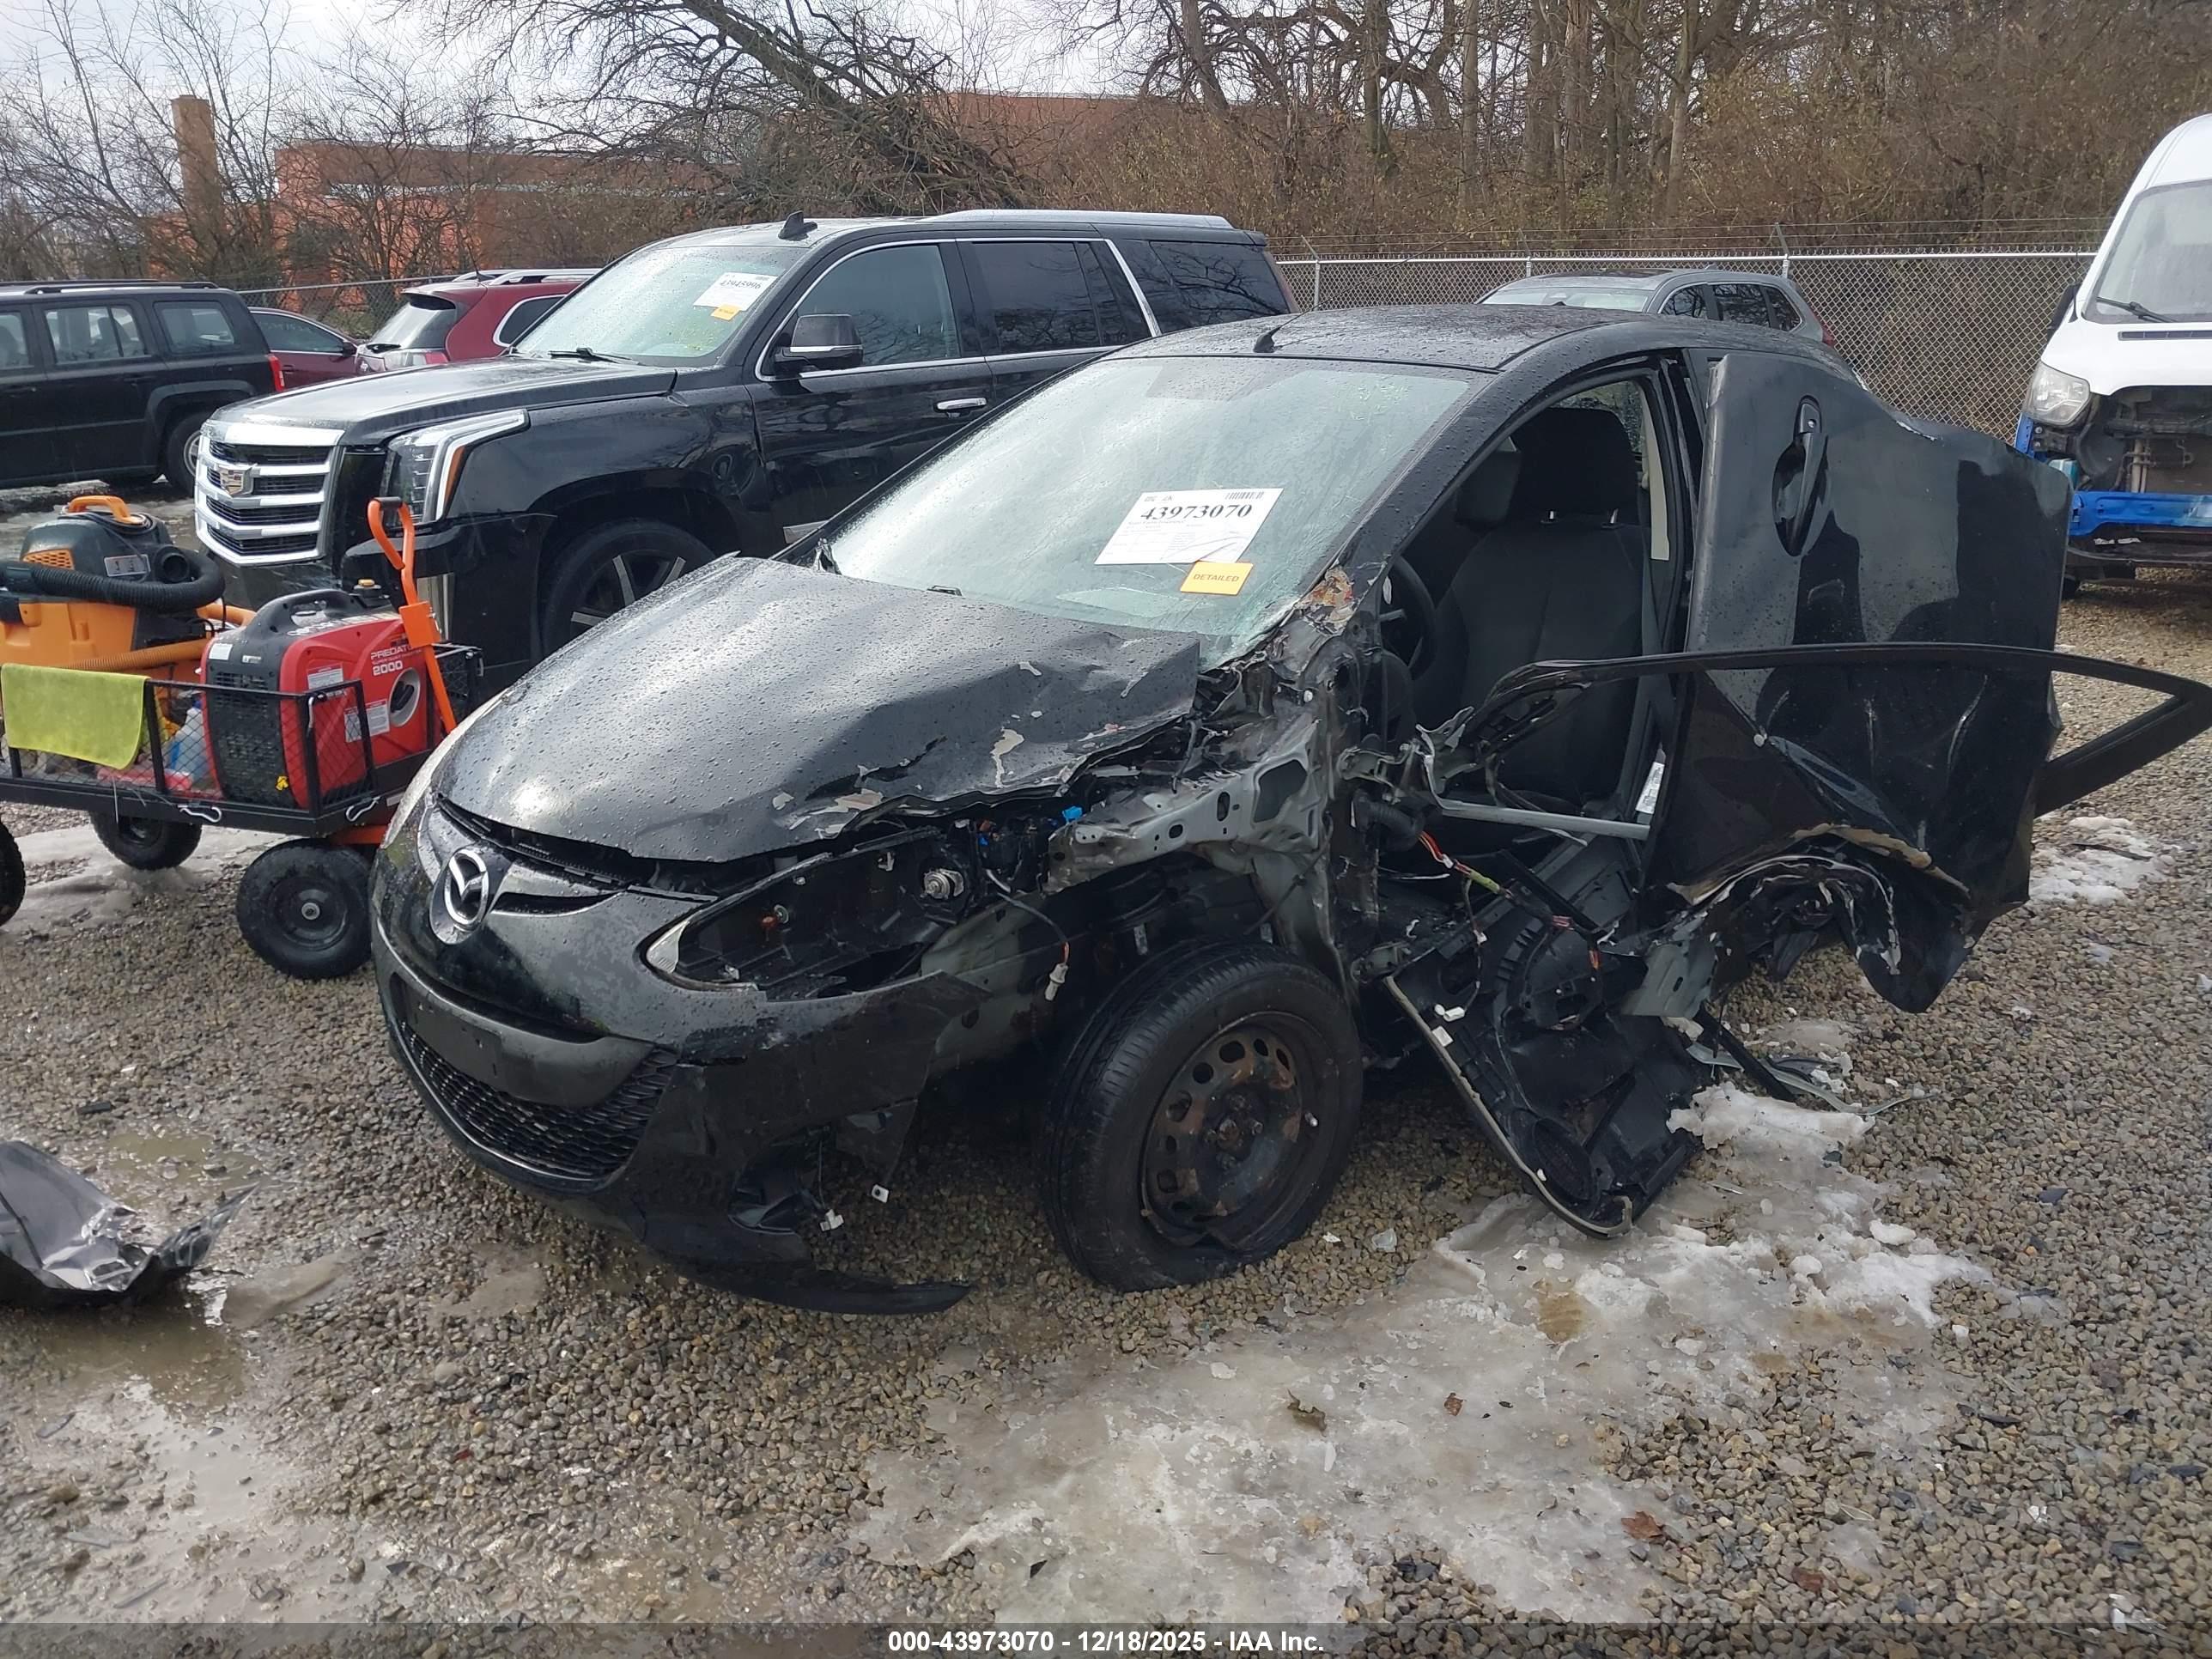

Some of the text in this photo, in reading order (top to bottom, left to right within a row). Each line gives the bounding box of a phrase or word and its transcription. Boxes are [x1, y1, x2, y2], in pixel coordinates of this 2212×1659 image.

[1140, 504, 1252, 520] 43973070
[1193, 573, 1240, 583] DETAILED
[370, 644, 412, 659] PREDATO
[373, 660, 403, 676] 2000
